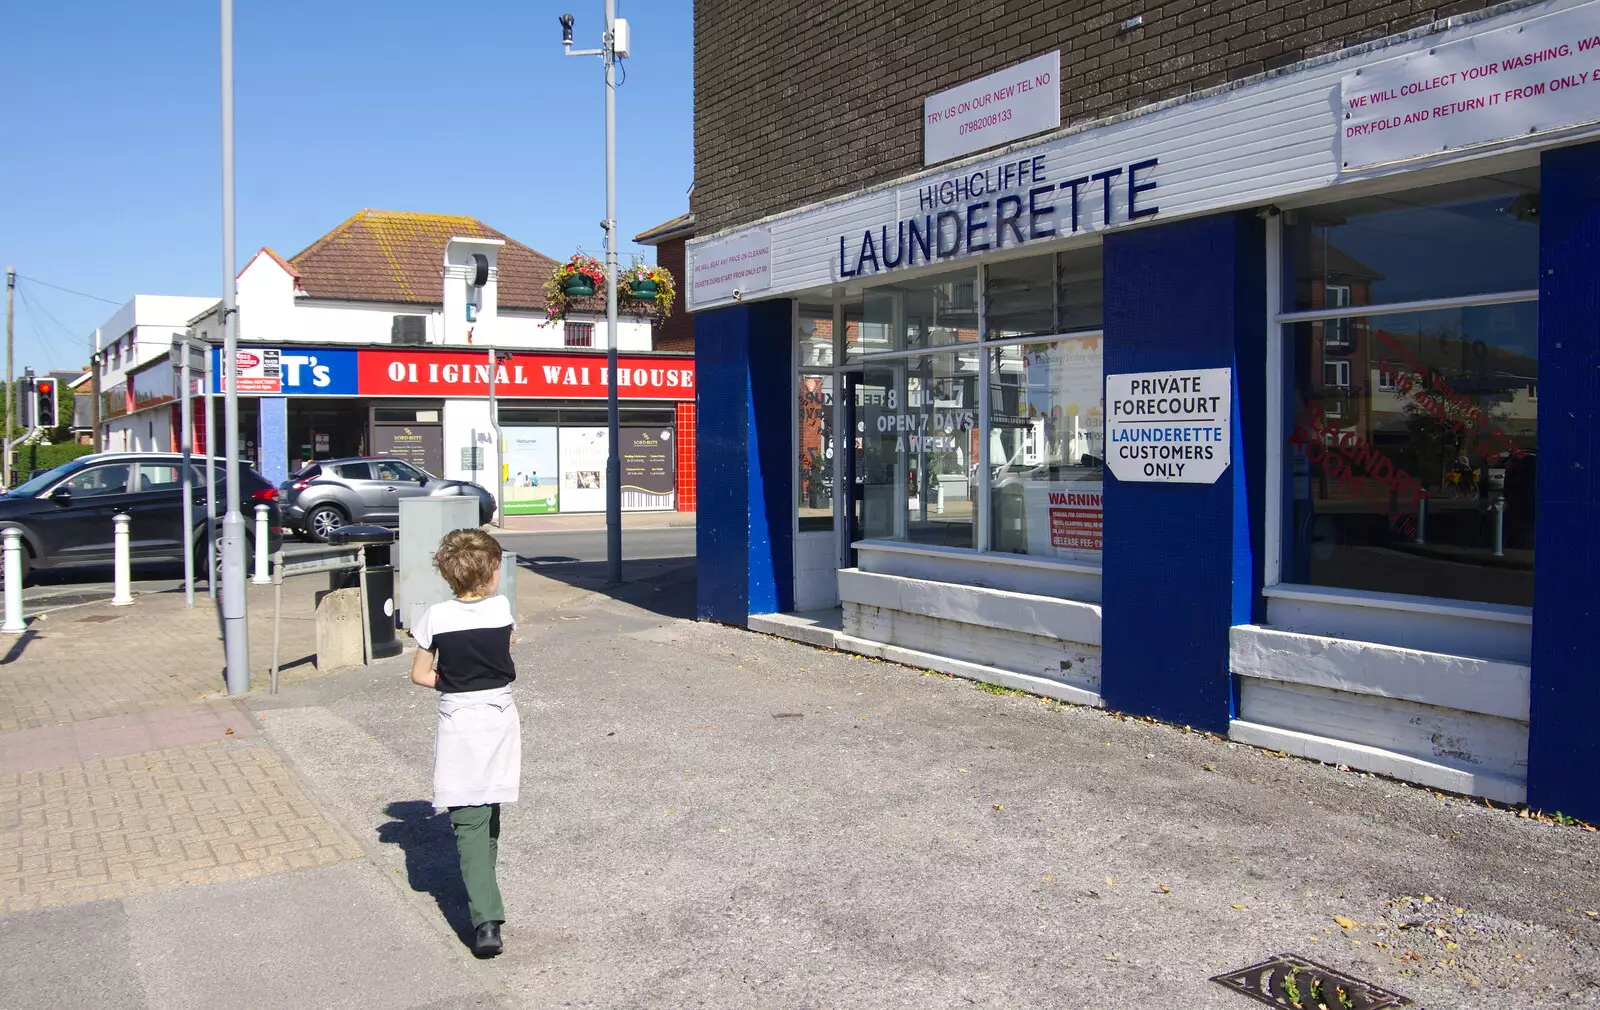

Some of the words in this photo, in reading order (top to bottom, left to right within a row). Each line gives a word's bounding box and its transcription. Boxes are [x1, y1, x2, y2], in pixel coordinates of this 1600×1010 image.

[1349, 96, 1368, 109] WE
[1370, 88, 1398, 104] WILL
[1400, 73, 1457, 96] COLLECT
[1461, 63, 1498, 81] YOUR
[1502, 44, 1573, 72] WASHING,
[927, 112, 944, 125] TRY
[944, 106, 956, 119] US
[957, 102, 971, 115] ON
[972, 93, 992, 110] OUR
[993, 84, 1015, 102] NEW
[1016, 79, 1034, 94] TEL
[1035, 72, 1051, 87] NO
[1404, 109, 1430, 126] AND
[1432, 97, 1485, 119] RETURN
[1489, 92, 1501, 106] IT
[1505, 82, 1546, 103] FROM
[1549, 71, 1590, 92] ONLY
[959, 108, 1012, 136] 07982008133
[919, 154, 1047, 212] HIGHCLIFFE
[839, 157, 1160, 278] LAUNDERETTE
[728, 254, 741, 264] PRICE
[741, 252, 748, 260] ON
[747, 247, 770, 258] CLEANING
[1131, 376, 1201, 395] PRIVATE
[887, 389, 897, 410] 8
[1114, 396, 1221, 415] FORECOURT
[877, 414, 916, 432] OPEN
[920, 413, 929, 431] 7
[933, 412, 974, 431] DAYS
[895, 436, 905, 453] A
[908, 435, 954, 453] WEEK
[1112, 427, 1222, 442] LAUNDERETTE
[1119, 445, 1214, 460] CUSTOMERS
[1288, 424, 1366, 497] ROOM
[1143, 462, 1186, 477] ONLY
[1053, 536, 1079, 546] RELEASE
